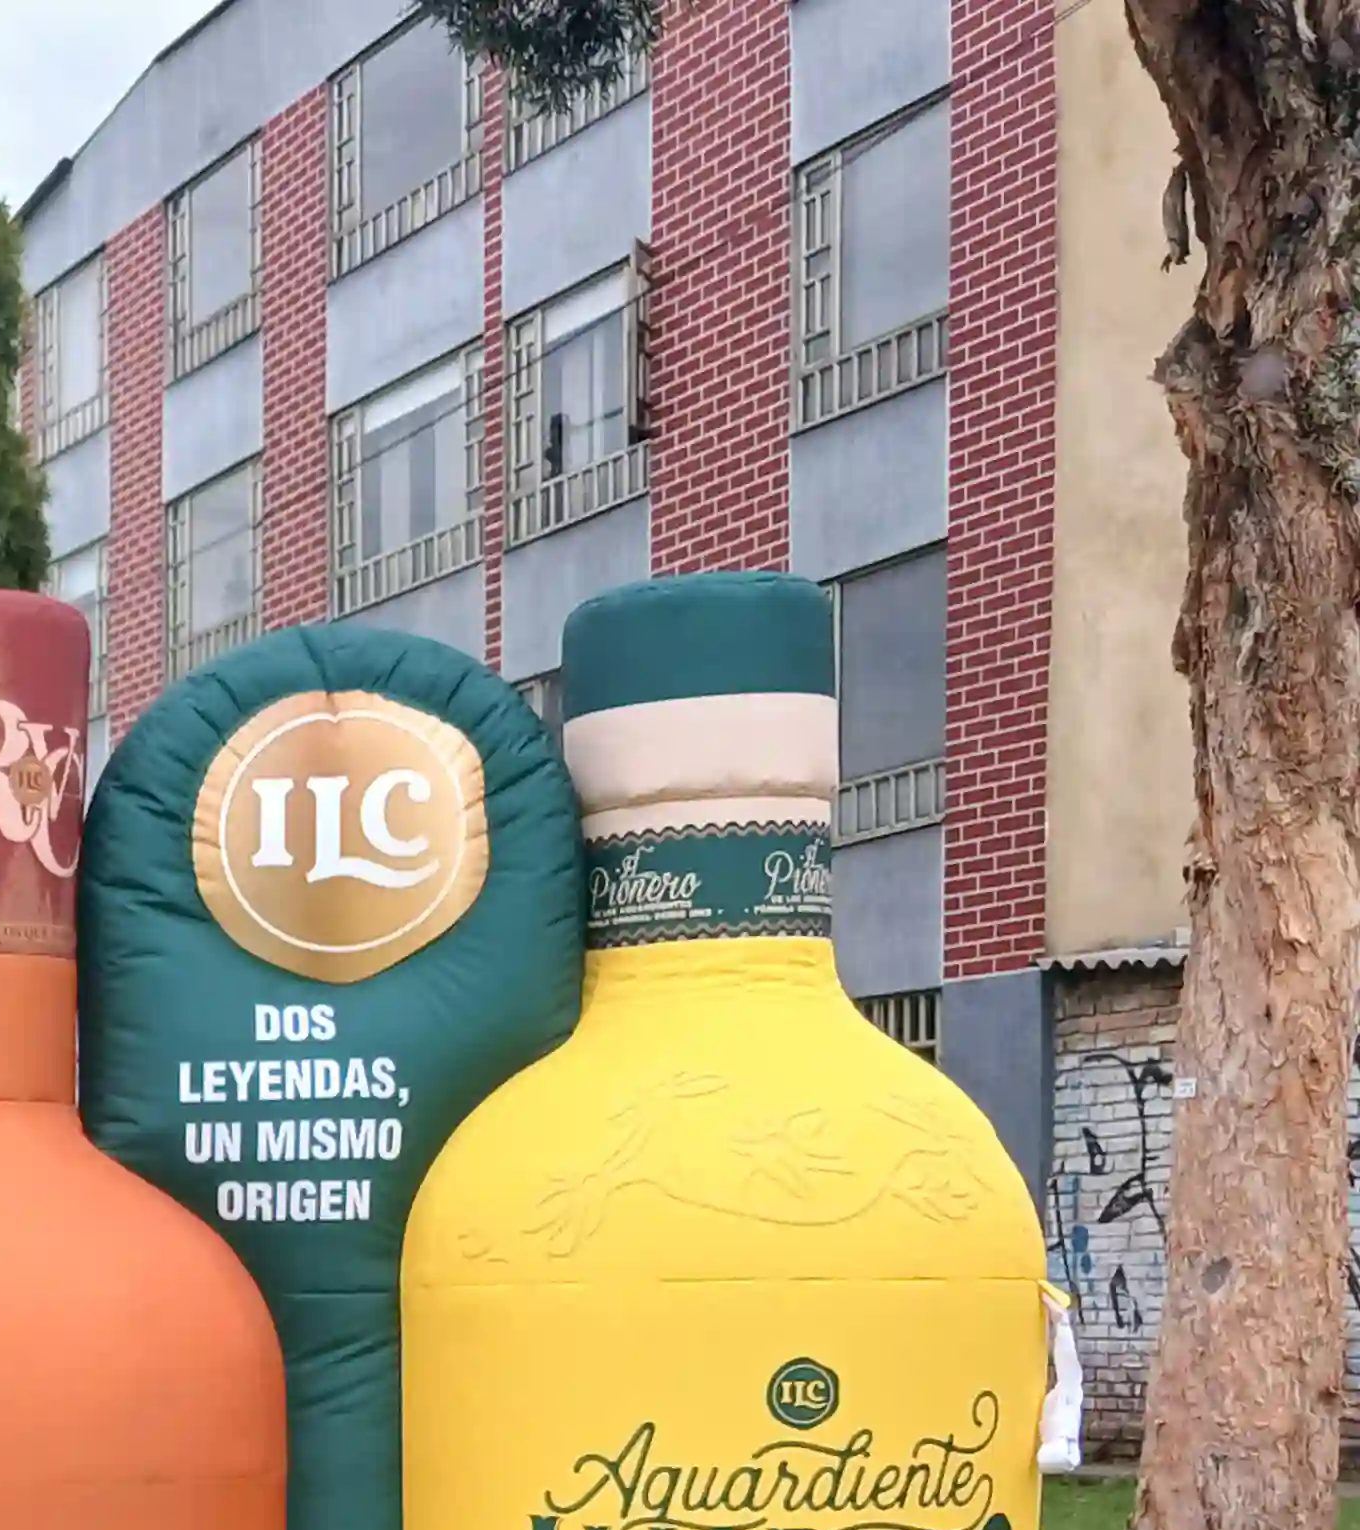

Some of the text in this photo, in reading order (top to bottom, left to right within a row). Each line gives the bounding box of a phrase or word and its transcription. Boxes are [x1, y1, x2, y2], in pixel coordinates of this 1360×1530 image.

[251, 769, 440, 888] ILC
[589, 866, 703, 912] Pionero
[764, 850, 831, 901] Pione
[254, 1003, 337, 1043] DOS
[178, 1057, 411, 1107] LEYENDAS,
[184, 1118, 402, 1164] UN MISMO
[216, 1179, 372, 1223] ORIGEN
[780, 1379, 828, 1407] ILC
